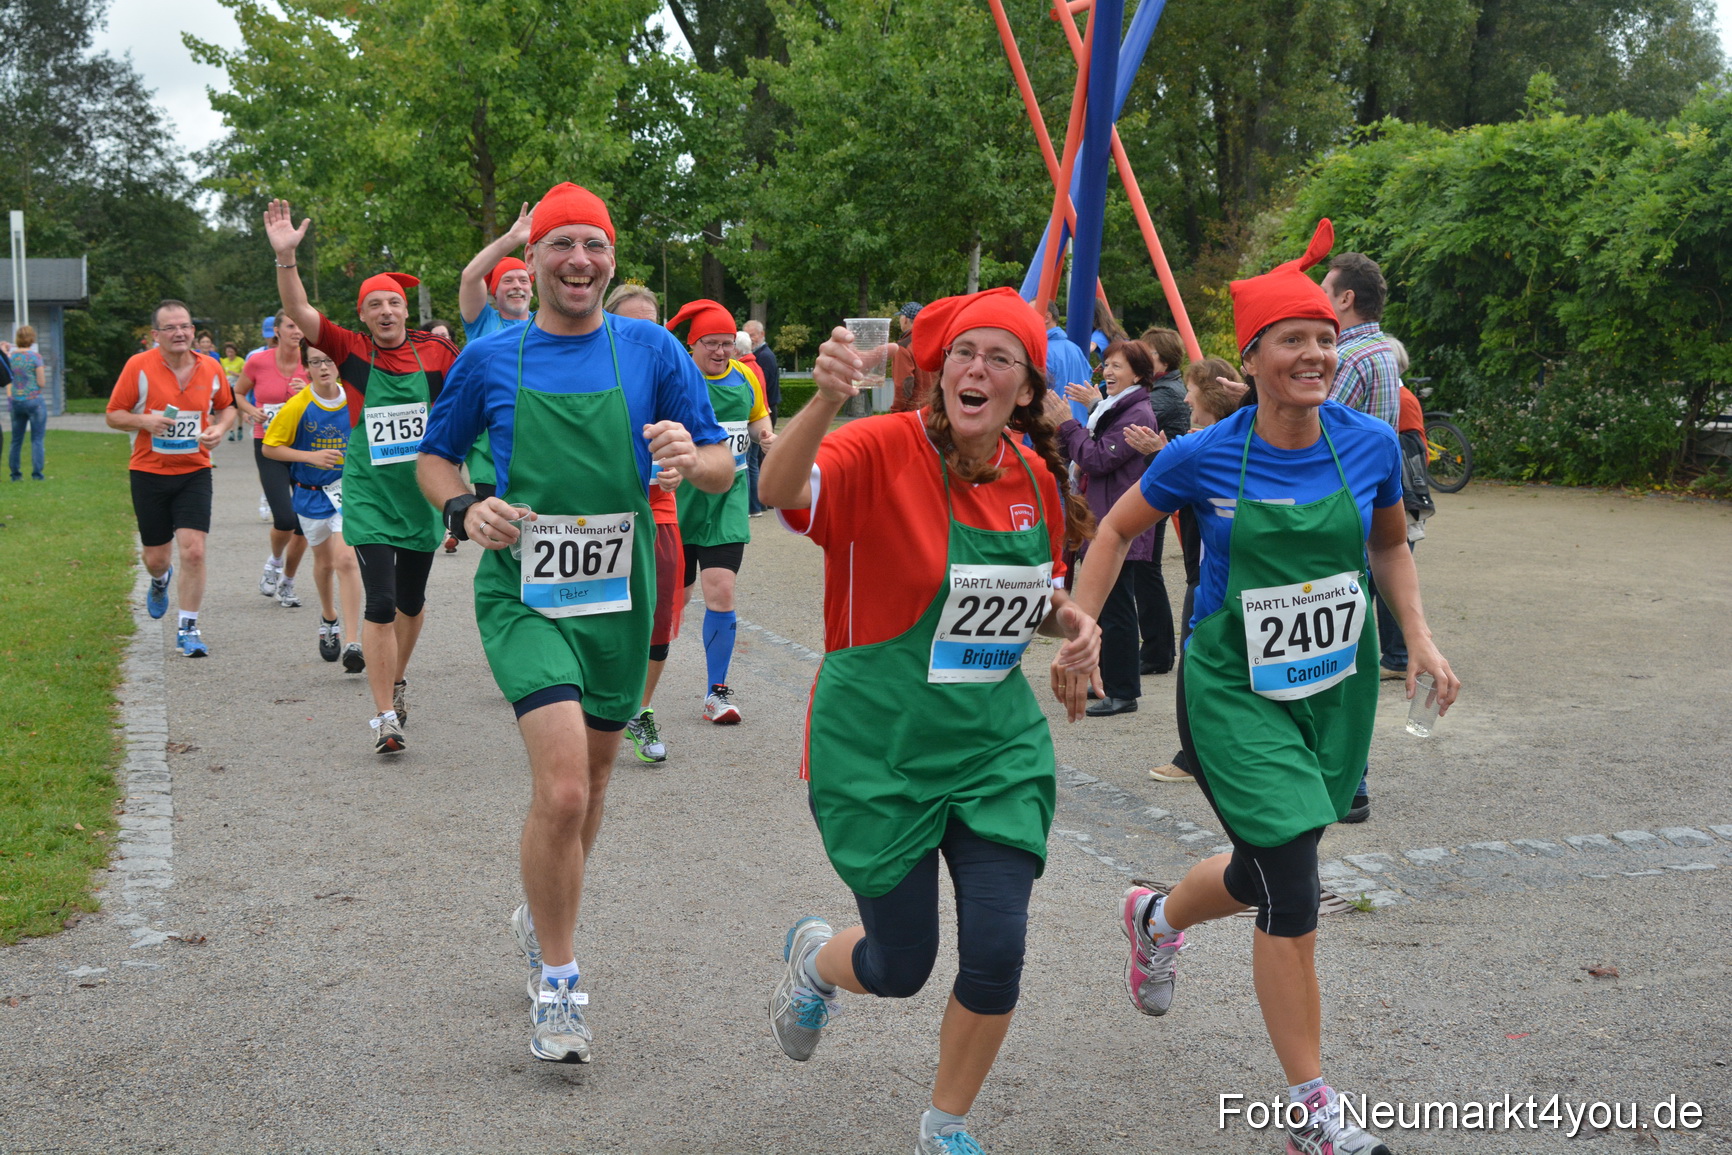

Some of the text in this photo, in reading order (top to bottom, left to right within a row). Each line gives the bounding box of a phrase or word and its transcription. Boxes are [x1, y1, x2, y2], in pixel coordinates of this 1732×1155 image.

[387, 409, 418, 418] Neumarkt
[161, 421, 197, 438] 922
[372, 417, 424, 443] 2153
[524, 524, 617, 535] PARTL Neumarkt
[533, 538, 623, 578] 2067
[559, 587, 589, 602] Peter
[954, 577, 1045, 590] PARTL Neumarkt
[1246, 586, 1347, 613] PARTL Neumarkt
[949, 594, 1047, 637] 2224
[1260, 600, 1357, 659] 2407
[961, 648, 1017, 669] Brigitte
[1286, 659, 1338, 683] Carolin
